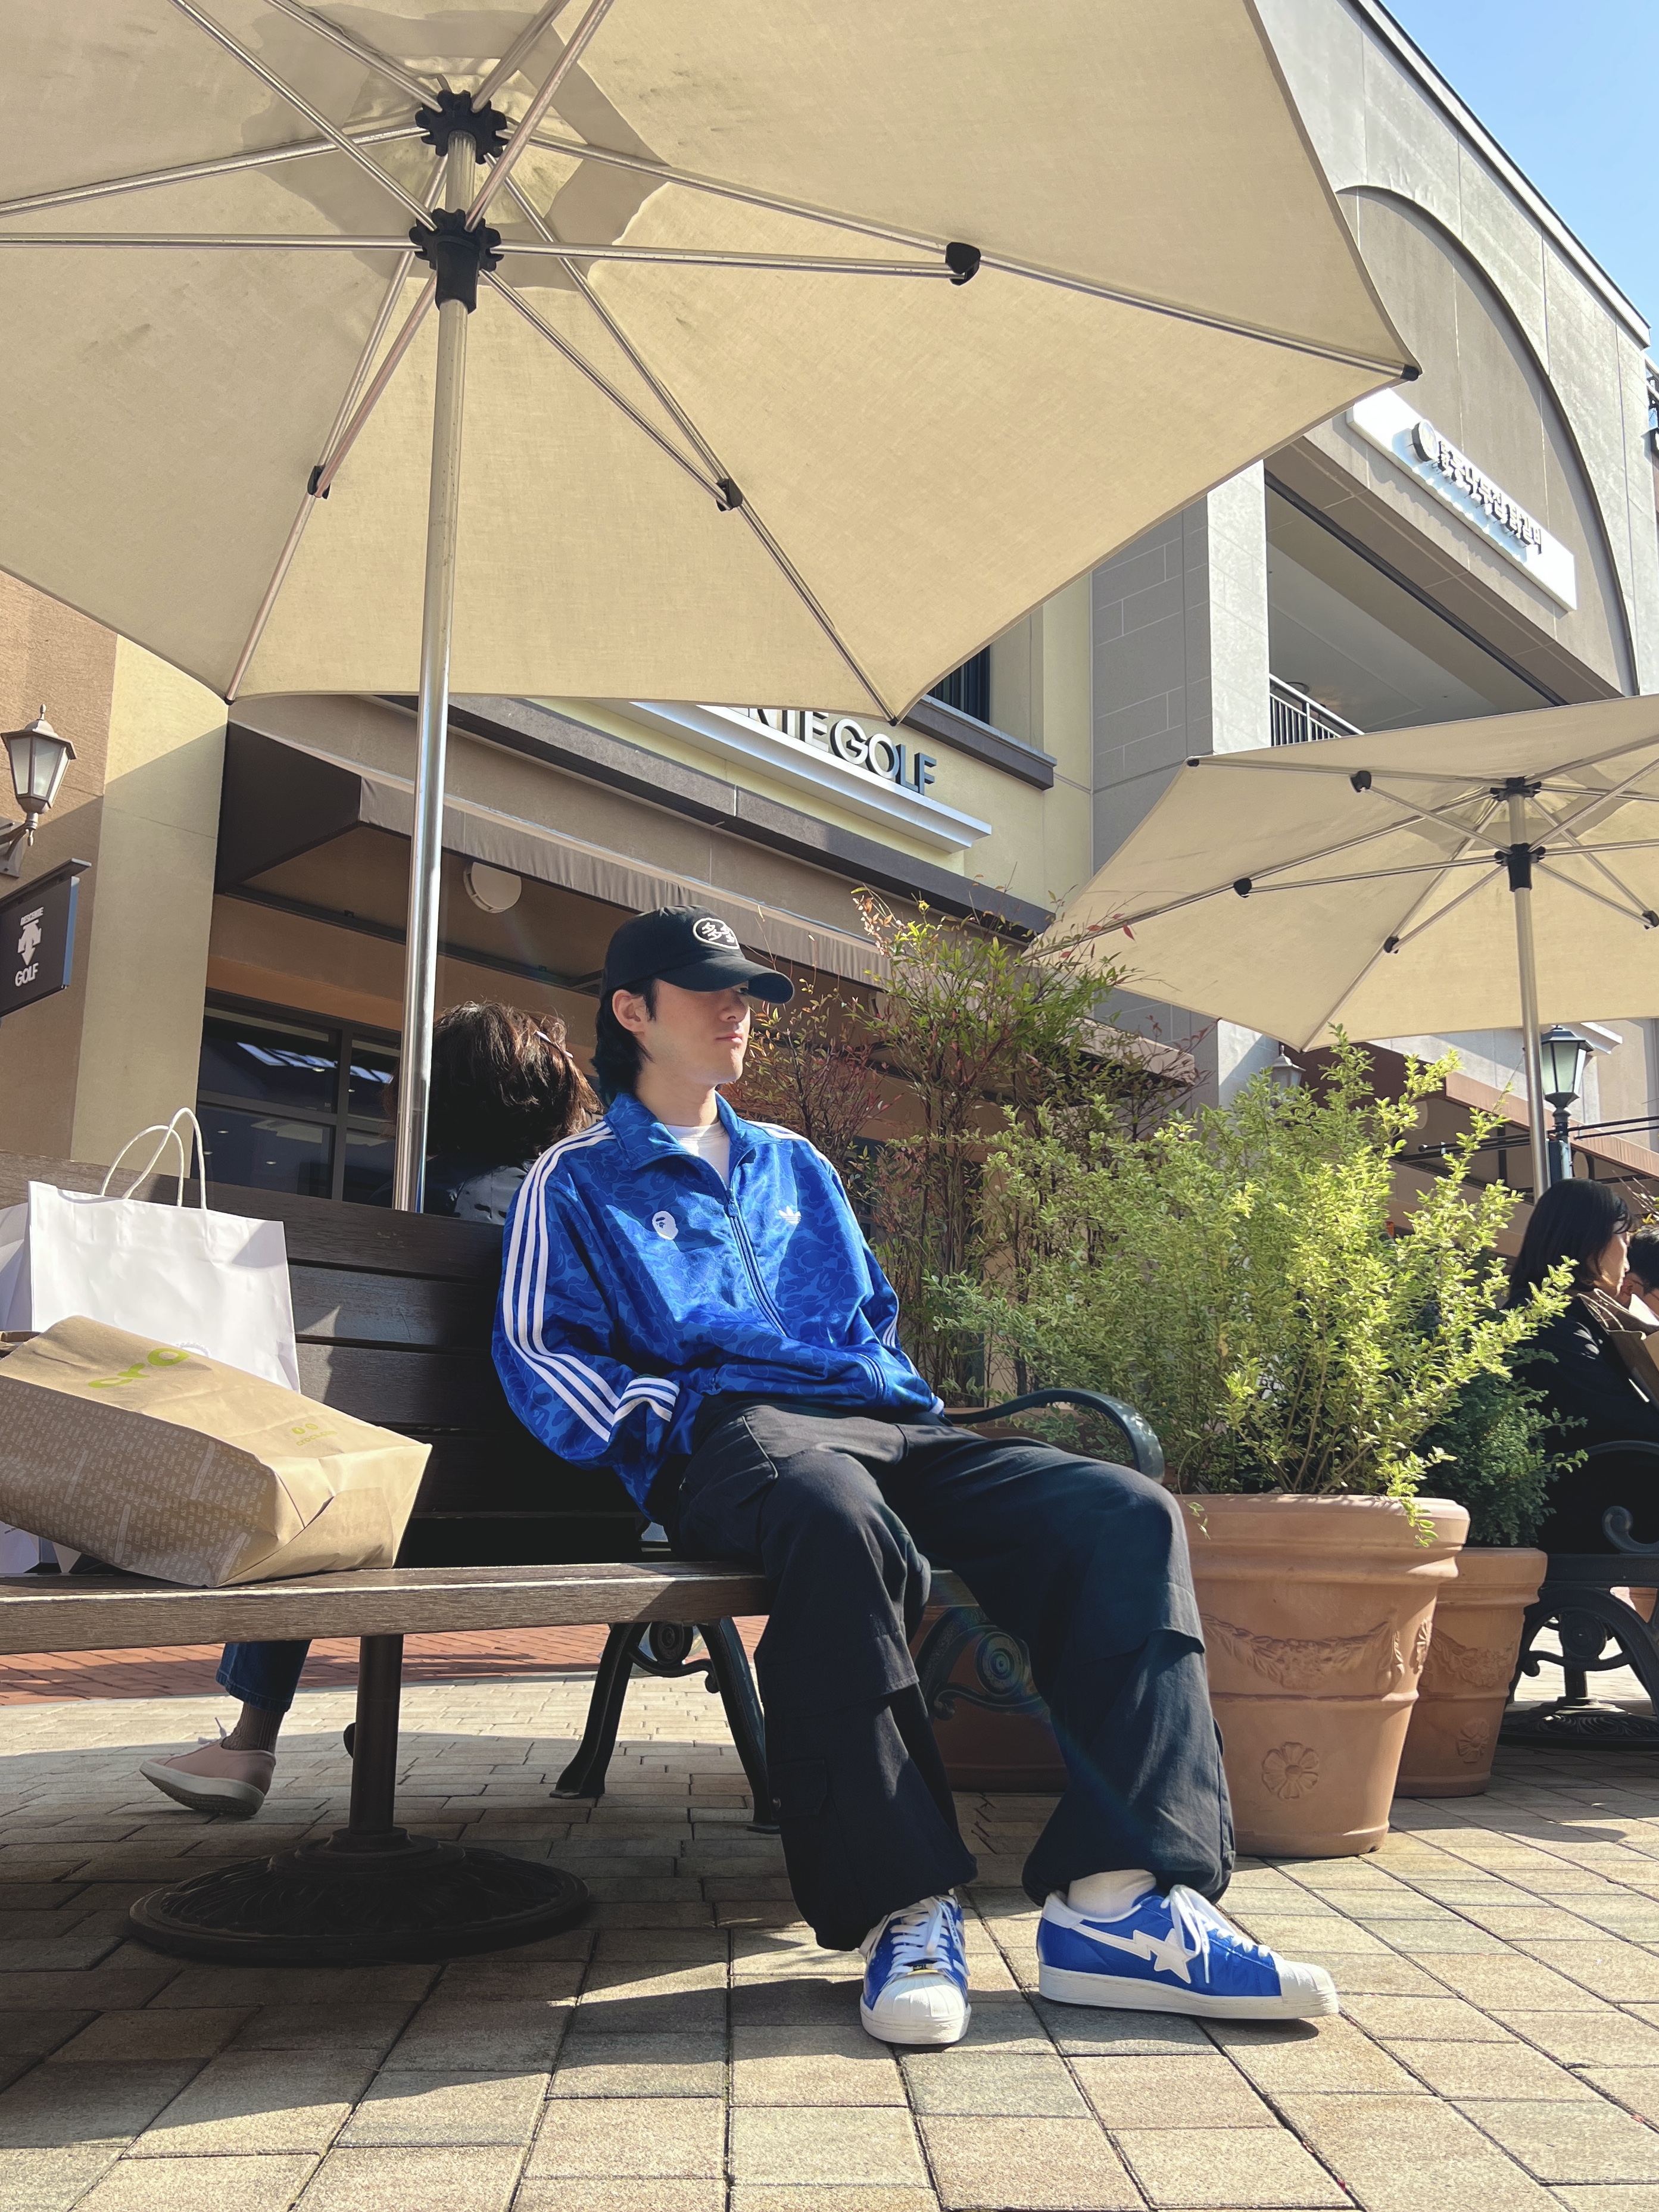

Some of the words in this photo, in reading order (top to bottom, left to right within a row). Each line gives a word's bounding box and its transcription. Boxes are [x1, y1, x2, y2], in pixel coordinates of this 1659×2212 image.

[15, 962, 39, 987] GOLF
[61, 1439, 69, 1448] YOU
[135, 1439, 144, 1449] YOU
[156, 1444, 164, 1455] YOU
[177, 1450, 186, 1461] YOU
[225, 1464, 233, 1474] YOU
[175, 1487, 182, 1496] AS
[179, 1472, 187, 1483] YOU
[202, 1480, 210, 1490] YOU
[225, 1486, 233, 1496] YOU
[249, 1492, 257, 1503] YOU
[222, 1500, 229, 1509] AS
[210, 1535, 216, 1543] AS
